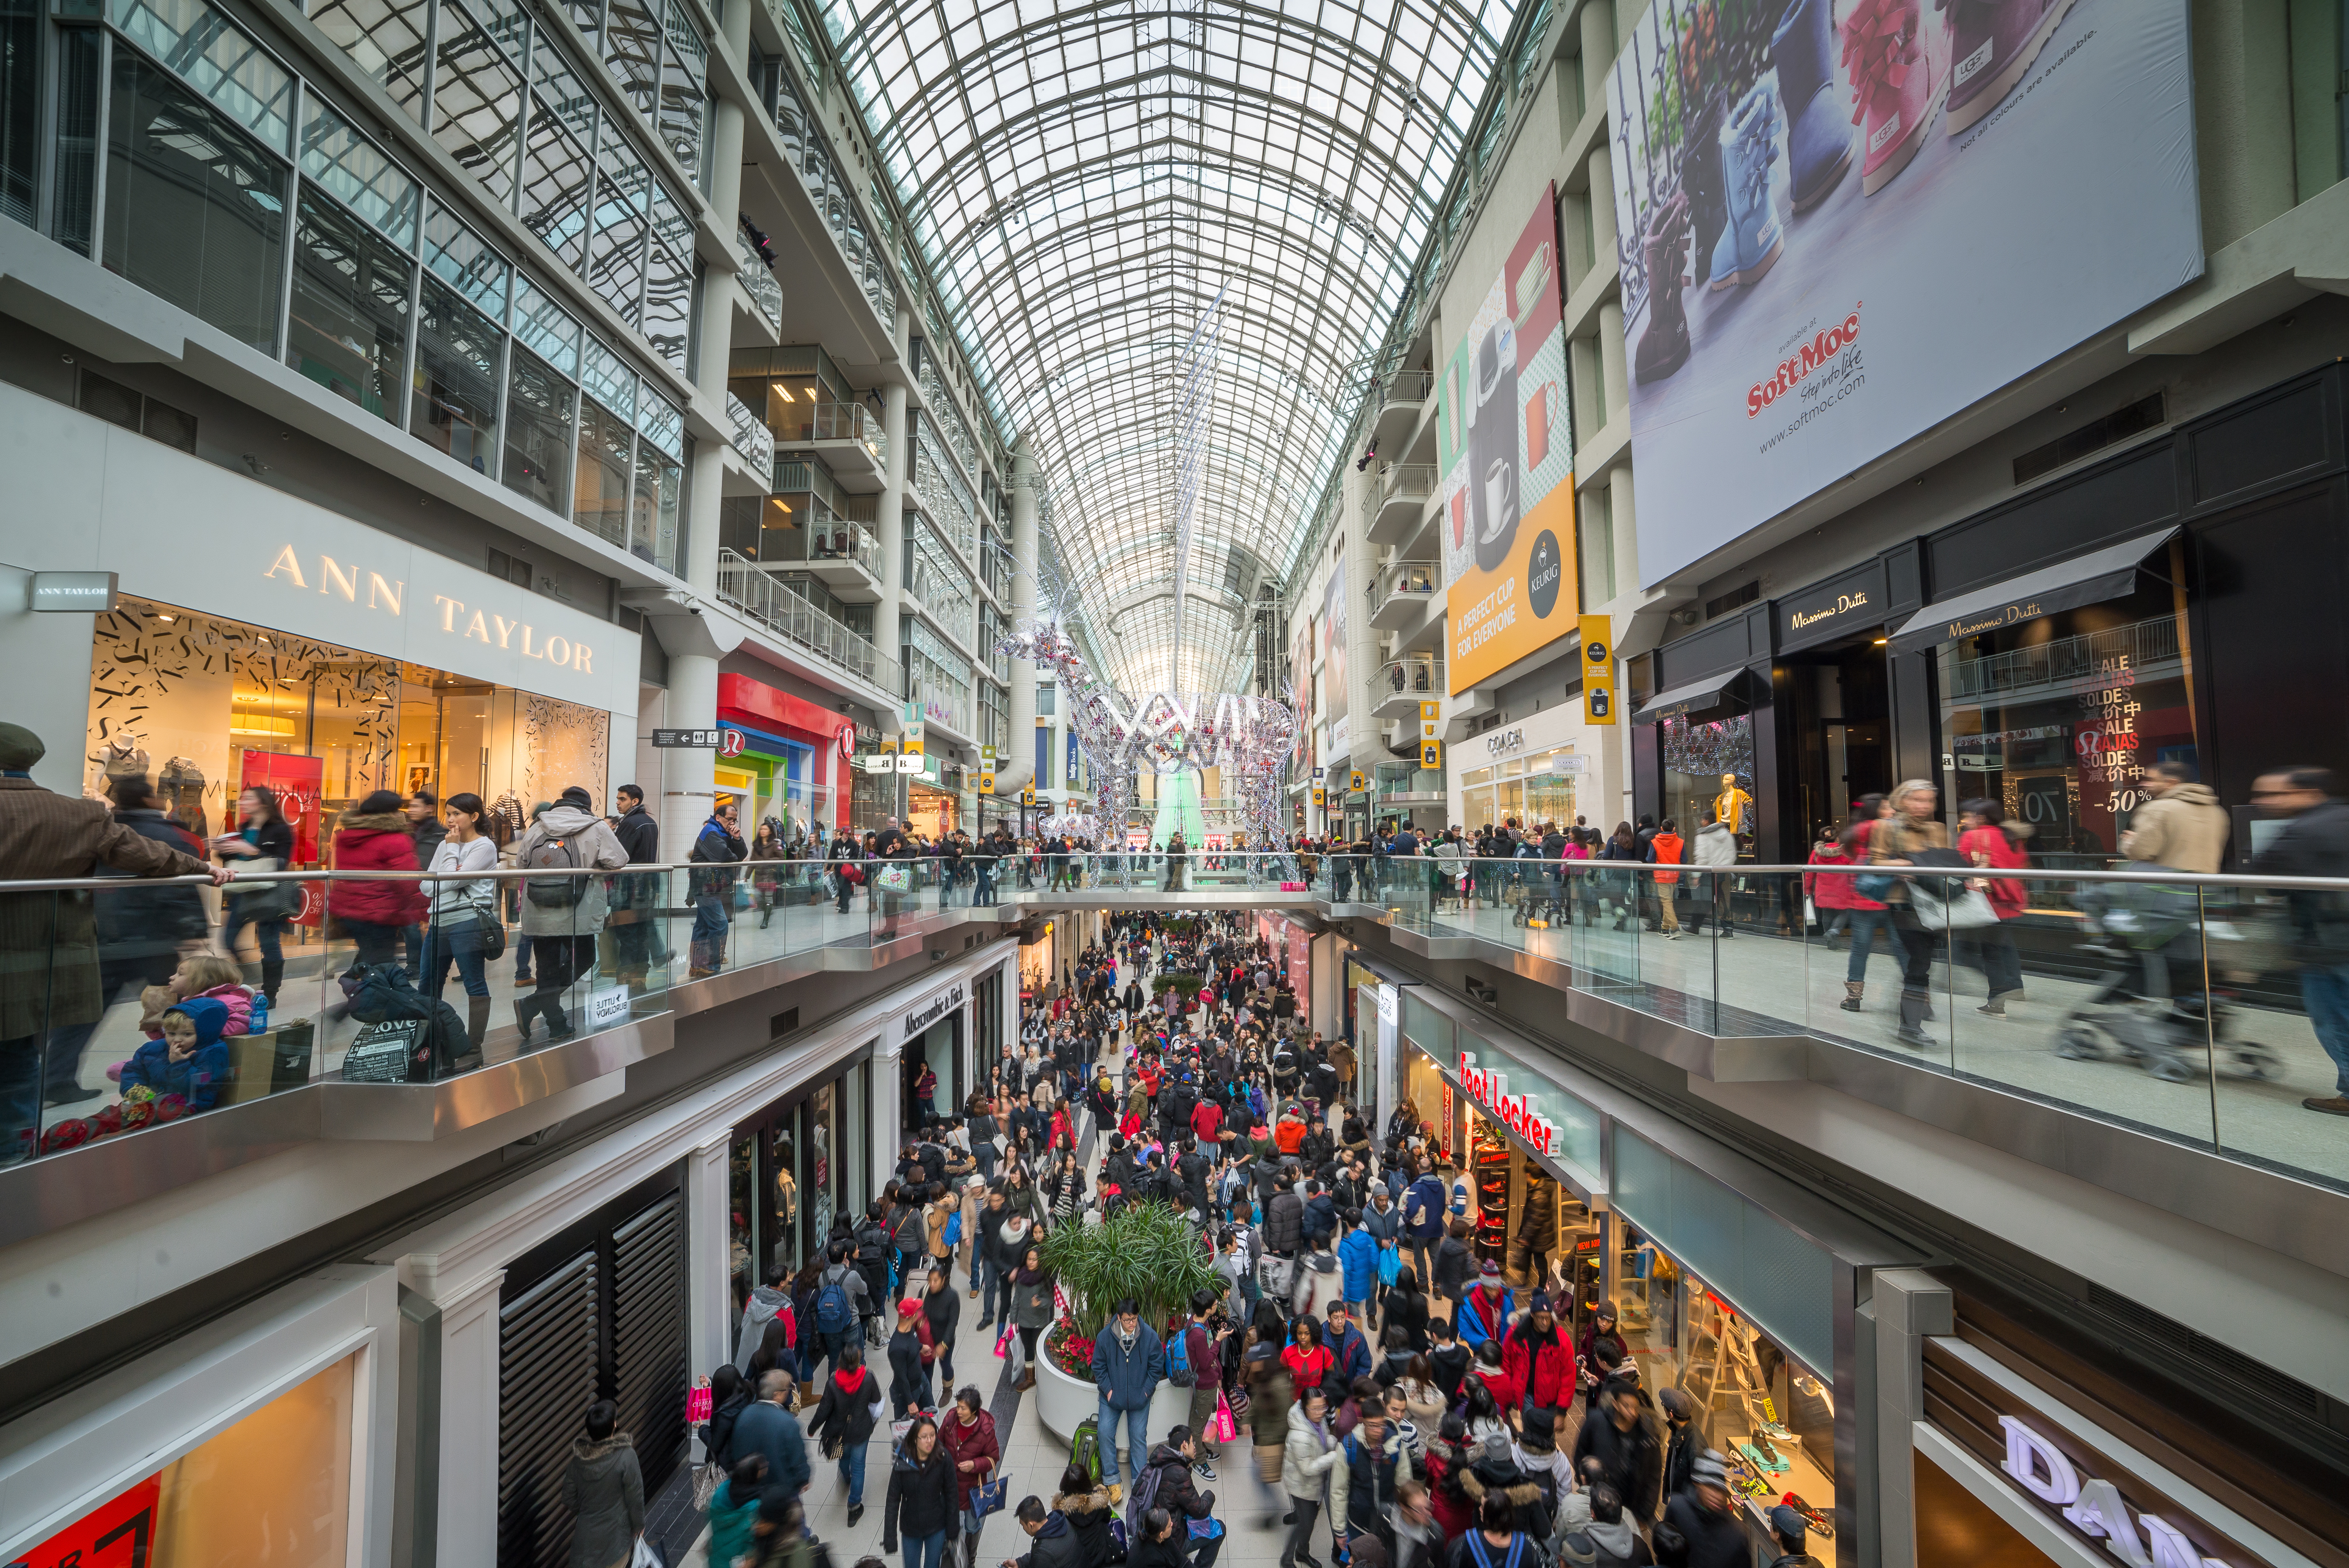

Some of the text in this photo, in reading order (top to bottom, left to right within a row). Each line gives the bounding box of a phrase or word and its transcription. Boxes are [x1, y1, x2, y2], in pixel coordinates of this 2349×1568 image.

[1961, 51, 1984, 75] UGG
[1961, 29, 2098, 153] Not all colours are available.
[1875, 122, 1893, 143] UGG
[1762, 219, 1773, 236] UGG
[1676, 320, 1685, 333] UGG
[1778, 316, 1817, 354] available at
[1746, 312, 1860, 419] SoftMoc
[1801, 344, 1863, 403] Step into life
[1759, 374, 1866, 454] www.softmoc.com
[1531, 563, 1558, 594] KEURIG
[263, 543, 594, 674] ANN TAYLOR
[1457, 577, 1515, 637] A PERFECT CUP
[1791, 591, 1868, 630] Massimo Dutti
[1457, 603, 1516, 660] FOR EVERYONE
[1948, 603, 2042, 639] Massimo Dutti
[2093, 655, 2129, 674] SALE
[2071, 669, 2135, 695] REBAJAS
[2078, 686, 2132, 709] SOLDES
[1655, 704, 1689, 720] Massimo Dutti
[2096, 718, 2134, 736] SALE
[1487, 728, 1524, 753] COACH
[2075, 732, 2139, 756] BAJAS
[2082, 750, 2136, 768] SOLDES
[1069, 764, 1077, 779] Indigo
[308, 906, 320, 915] OFF
[904, 982, 963, 1038] Abercrombie & Fitch
[374, 1041, 402, 1050] maximized
[1460, 1051, 1560, 1158] Foot Locker
[1480, 1152, 1509, 1164] NEW ARRIVALS
[815, 1209, 828, 1249] 50
[1577, 1241, 1590, 1250] NEW
[1220, 1414, 1232, 1438] PINK
